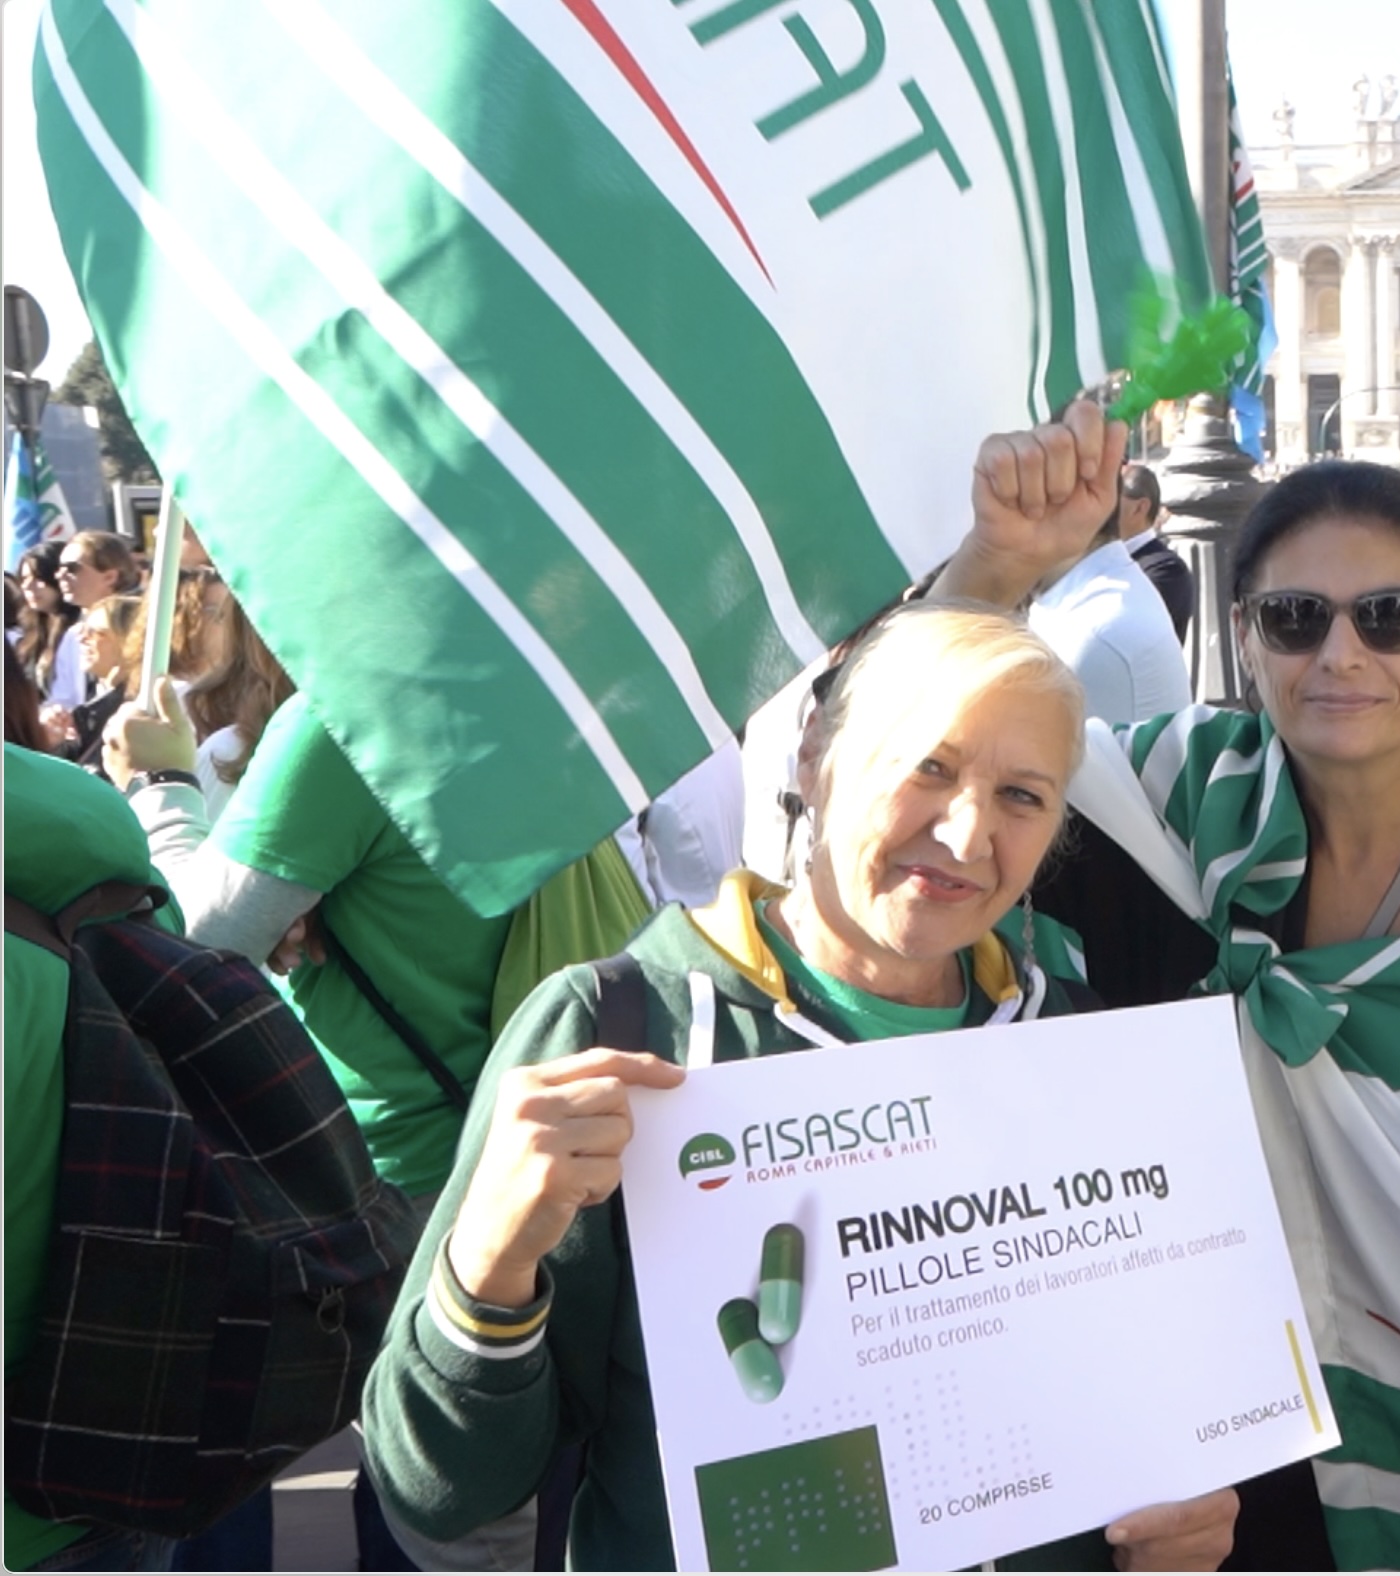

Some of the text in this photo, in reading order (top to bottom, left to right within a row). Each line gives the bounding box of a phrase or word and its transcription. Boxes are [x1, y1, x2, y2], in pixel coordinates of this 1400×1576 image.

[689, 1148, 725, 1165] CISL
[742, 1095, 932, 1168] FISASCAT
[746, 1164, 797, 1183] ROMA
[804, 1150, 876, 1172] CAPITALE
[900, 1138, 938, 1153] RIETI
[837, 1164, 1169, 1258] RINNOVAL 100 mg
[846, 1211, 1143, 1302] PILLOLE SINDACALI
[851, 1226, 1247, 1337] Per il trattamento dei lavoratori affetti da contratto
[856, 1316, 1009, 1367] scaduto cronico.
[1196, 1394, 1304, 1443] USO SINDACALE
[919, 1472, 1054, 1525] 20 COMPRSSE
